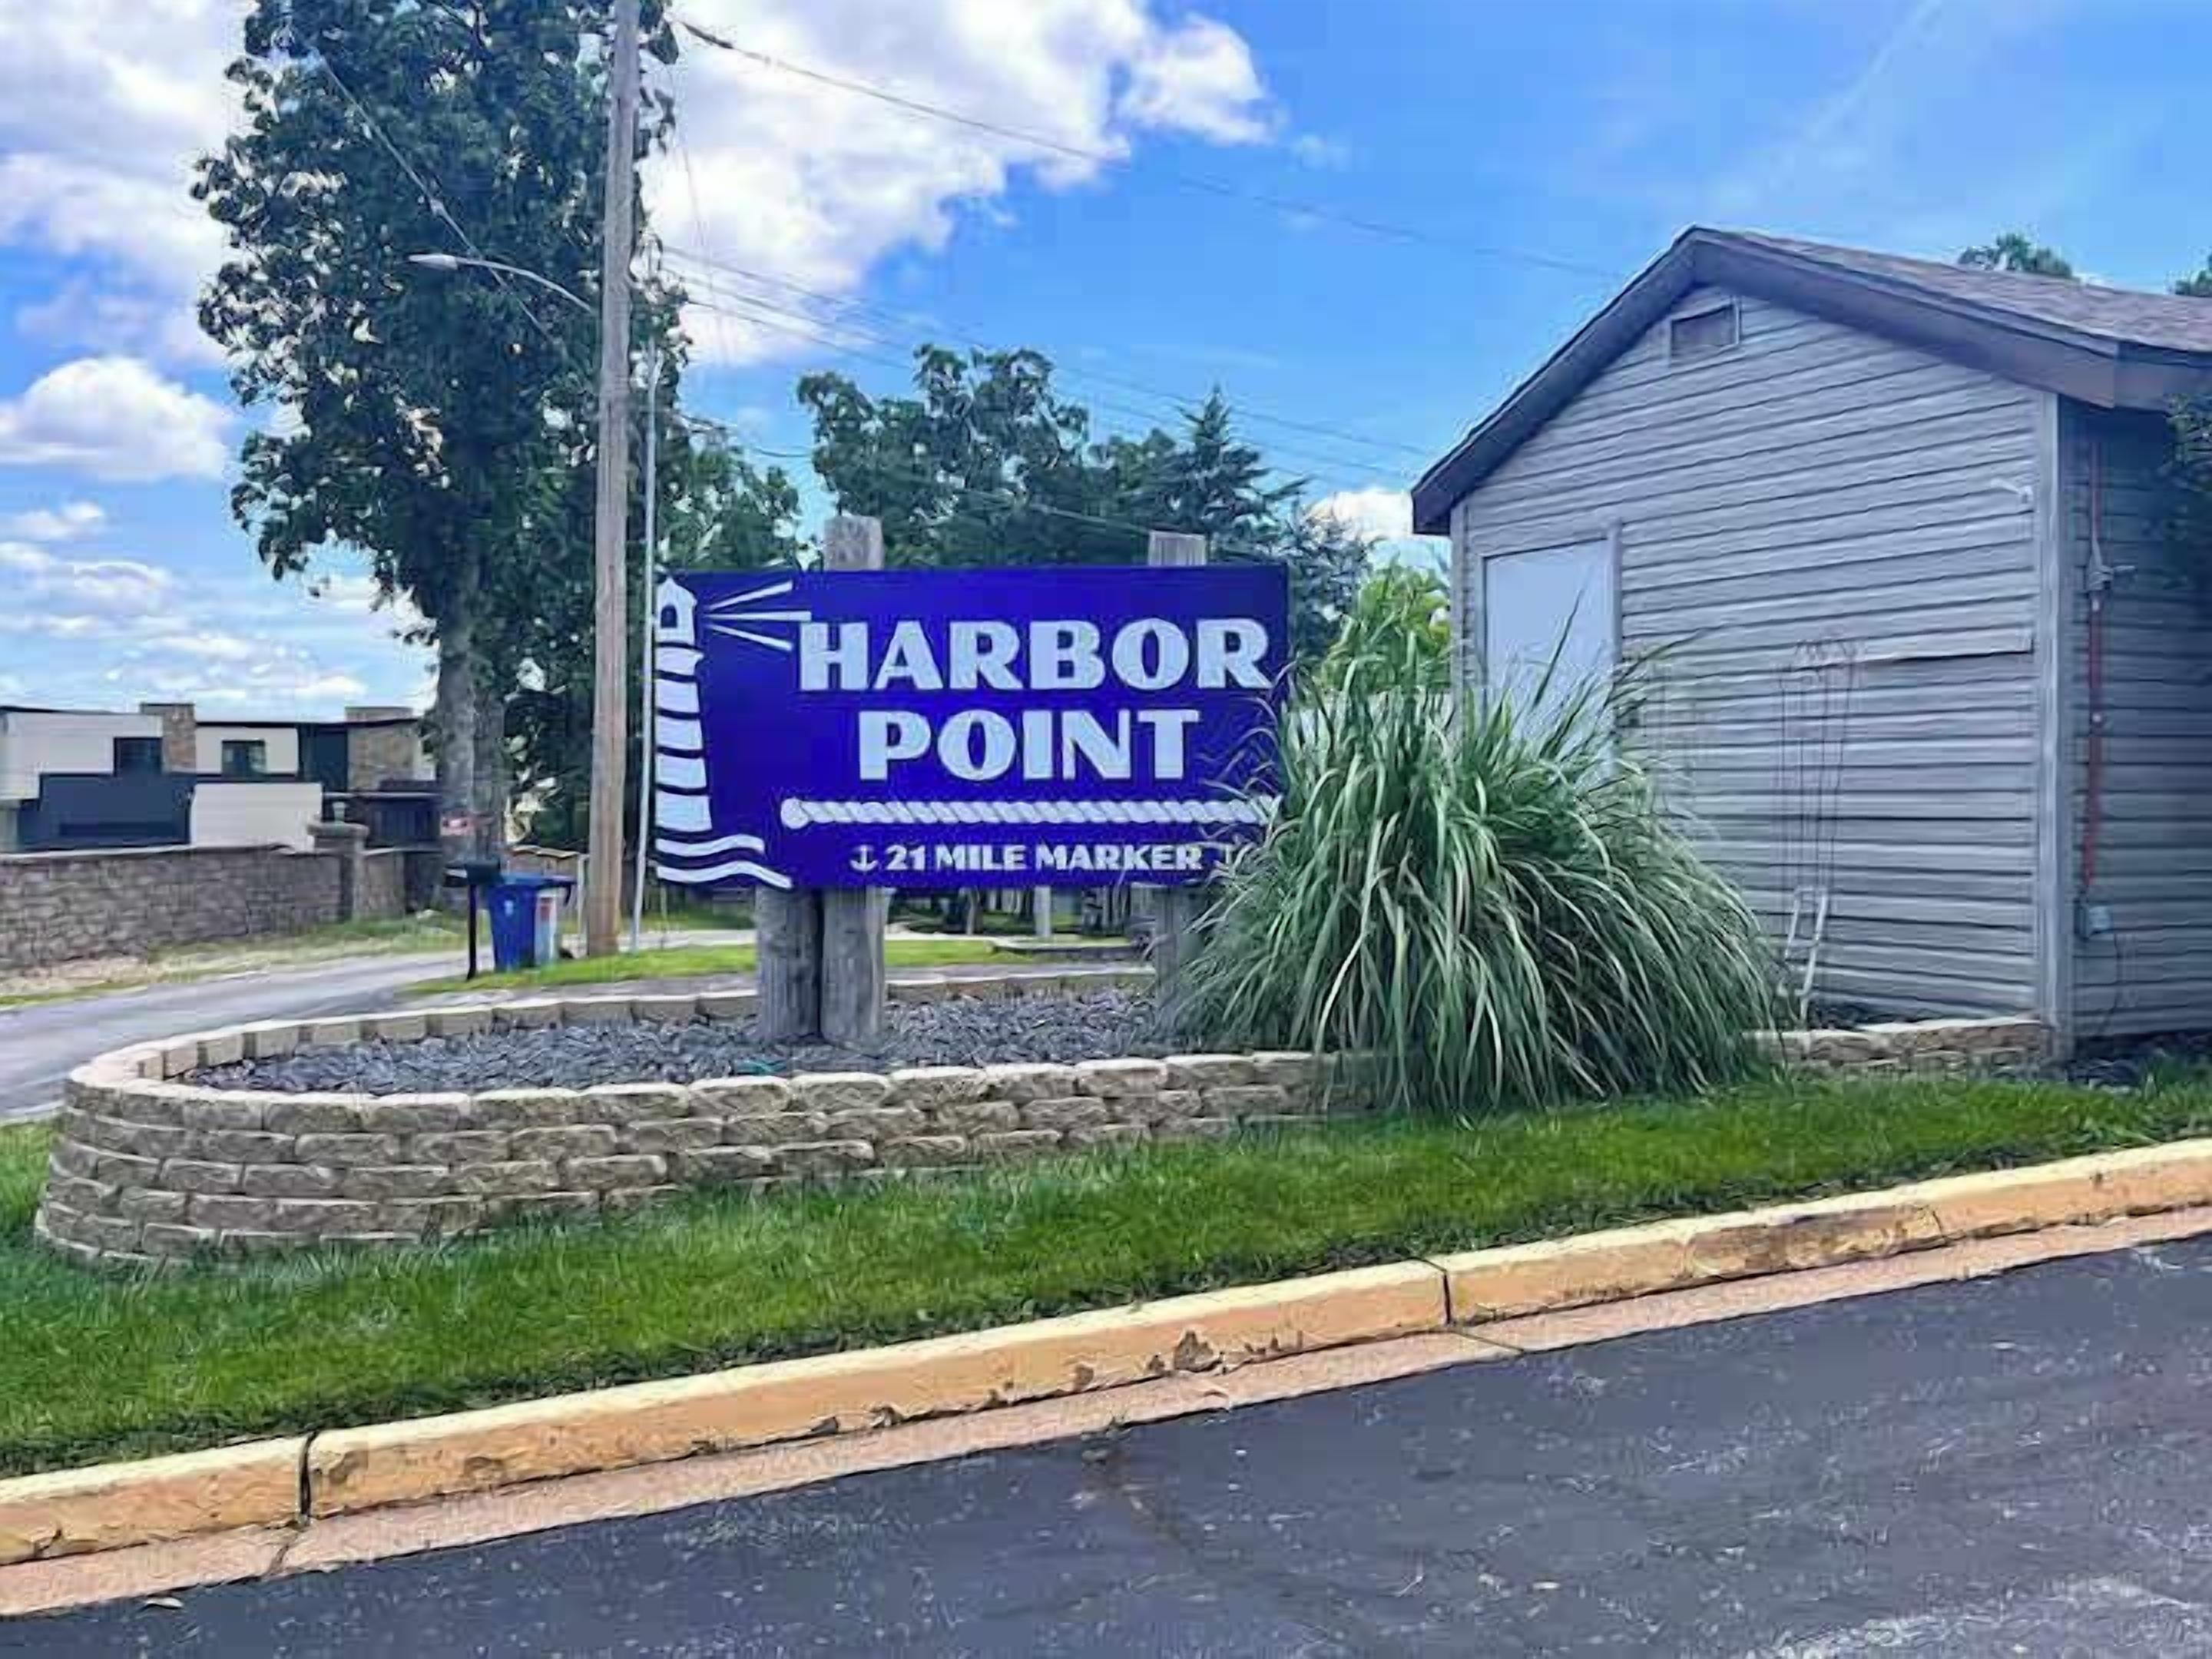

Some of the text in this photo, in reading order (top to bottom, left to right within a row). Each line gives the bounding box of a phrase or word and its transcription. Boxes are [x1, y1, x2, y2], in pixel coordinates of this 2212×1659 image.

[799, 618, 1272, 690] HARBOR
[859, 710, 1200, 781] POINT
[886, 845, 1203, 871] 21 MILE MARKER
